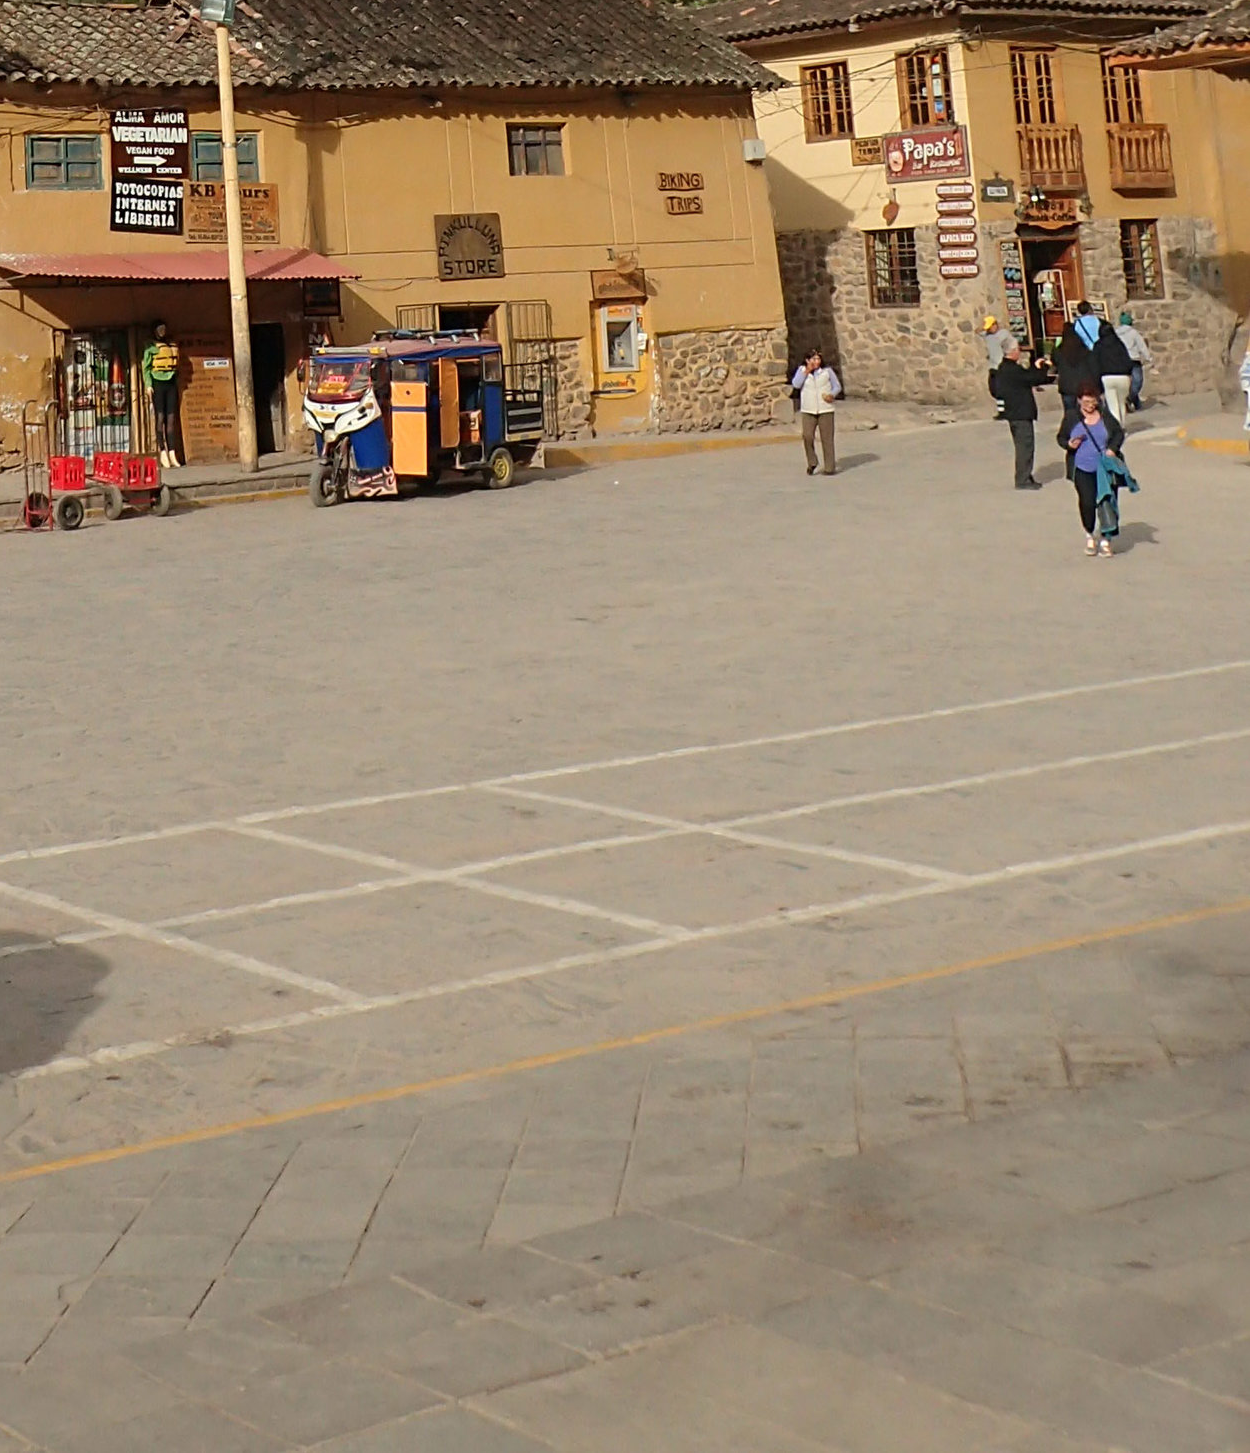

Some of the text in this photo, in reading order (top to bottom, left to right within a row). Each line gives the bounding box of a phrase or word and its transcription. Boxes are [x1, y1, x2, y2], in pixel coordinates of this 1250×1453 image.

[115, 111, 185, 124] ALMA AMOR
[112, 126, 188, 144] VEGETARIAN
[126, 146, 175, 155] VEGAN FOOD
[902, 137, 955, 166] Papa's
[659, 172, 700, 188] BIKING
[115, 182, 184, 199] FOTOCOPIAS
[189, 184, 216, 197] KB
[116, 197, 176, 212] INTERNET
[667, 196, 701, 211] TRIPS
[115, 211, 175, 227] LIBRERIA
[443, 259, 498, 276] STORE
